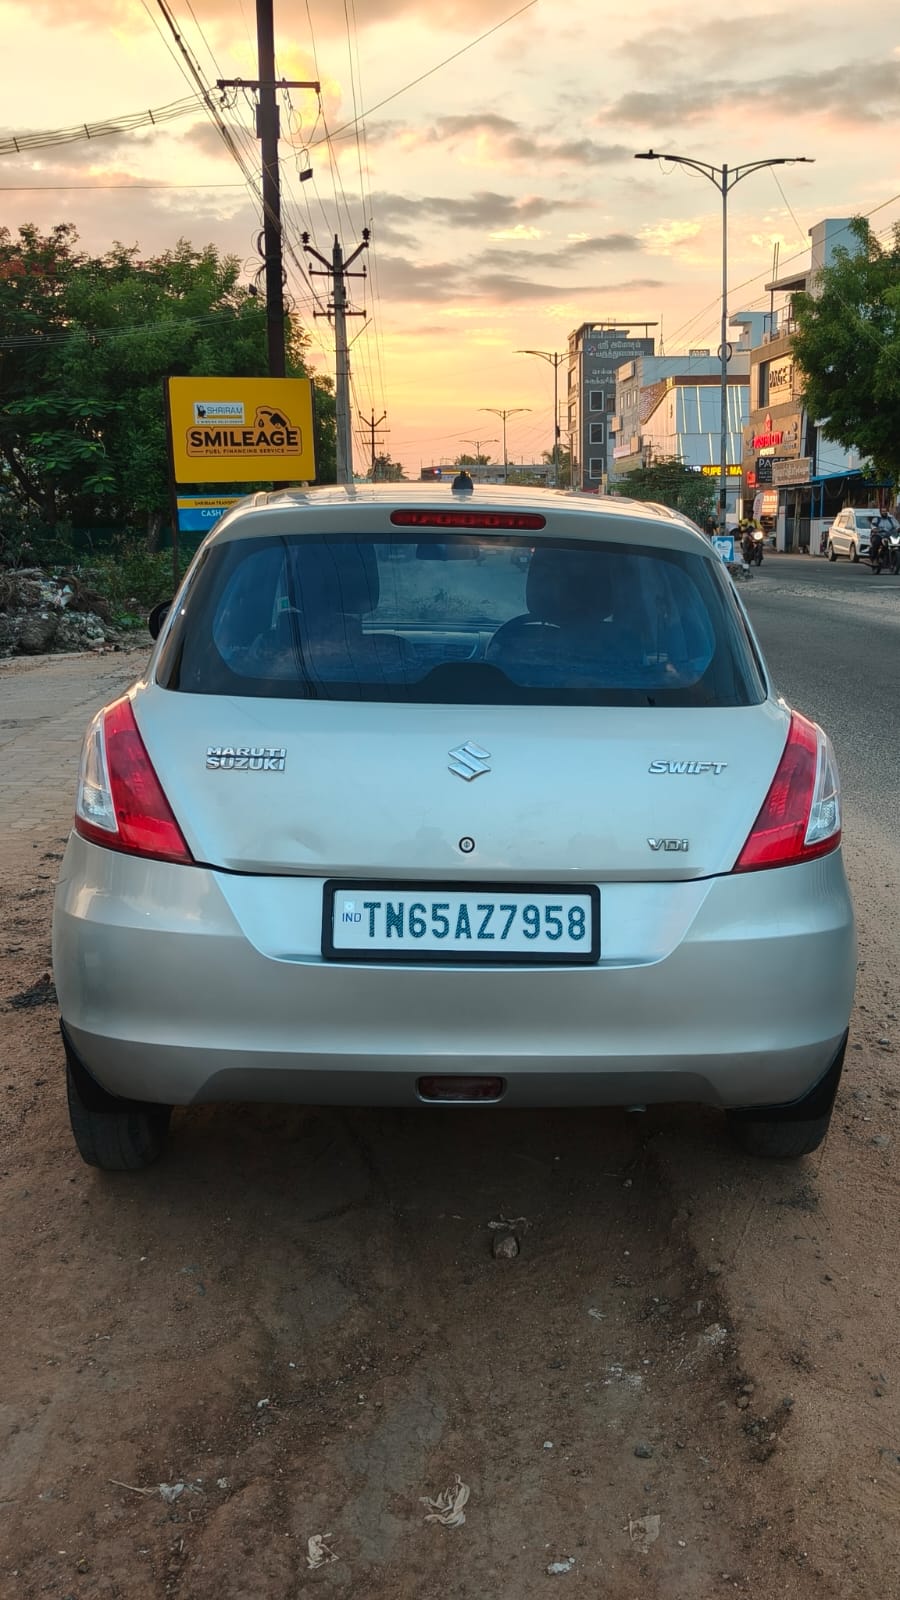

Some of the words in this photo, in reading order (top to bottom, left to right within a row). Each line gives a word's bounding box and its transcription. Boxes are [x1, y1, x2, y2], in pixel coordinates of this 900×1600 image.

[207, 406, 242, 414] SHRIRAM
[190, 430, 298, 447] SMILEAGE
[206, 746, 287, 758] MARUTI
[206, 757, 285, 771] SUZUKI
[647, 838, 689, 851] VDi
[342, 912, 362, 924] IND
[363, 902, 586, 941] TN65AZ7958
